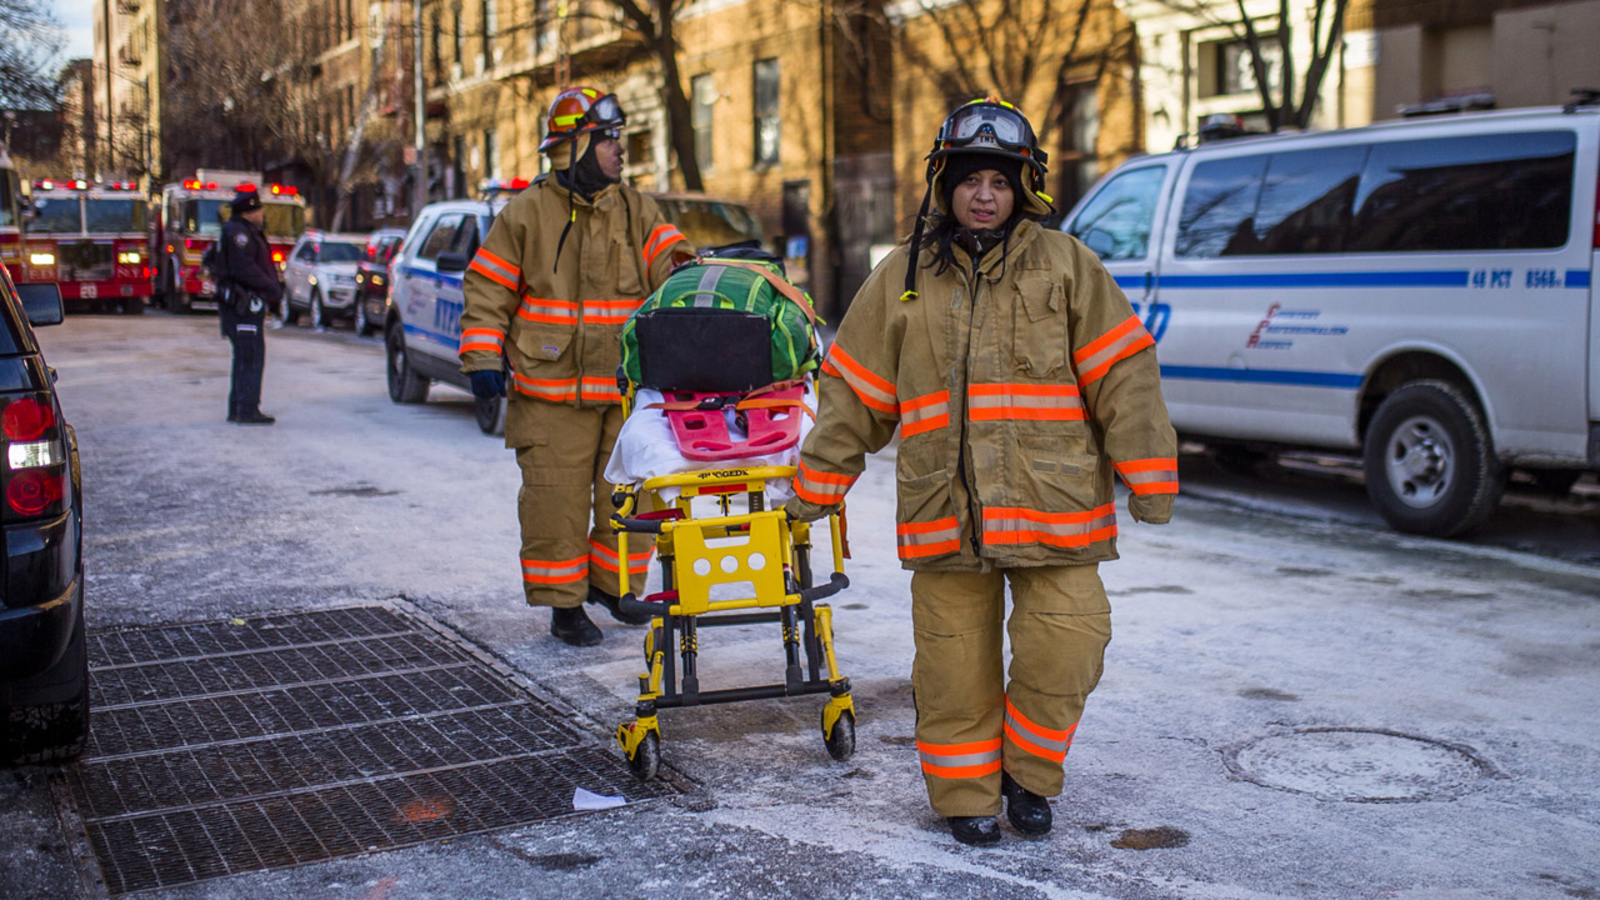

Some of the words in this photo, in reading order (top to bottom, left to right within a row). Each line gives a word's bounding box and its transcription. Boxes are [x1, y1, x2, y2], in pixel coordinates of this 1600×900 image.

[980, 135, 995, 143] EMS
[1490, 270, 1513, 289] PCT
[80, 284, 97, 299] 20
